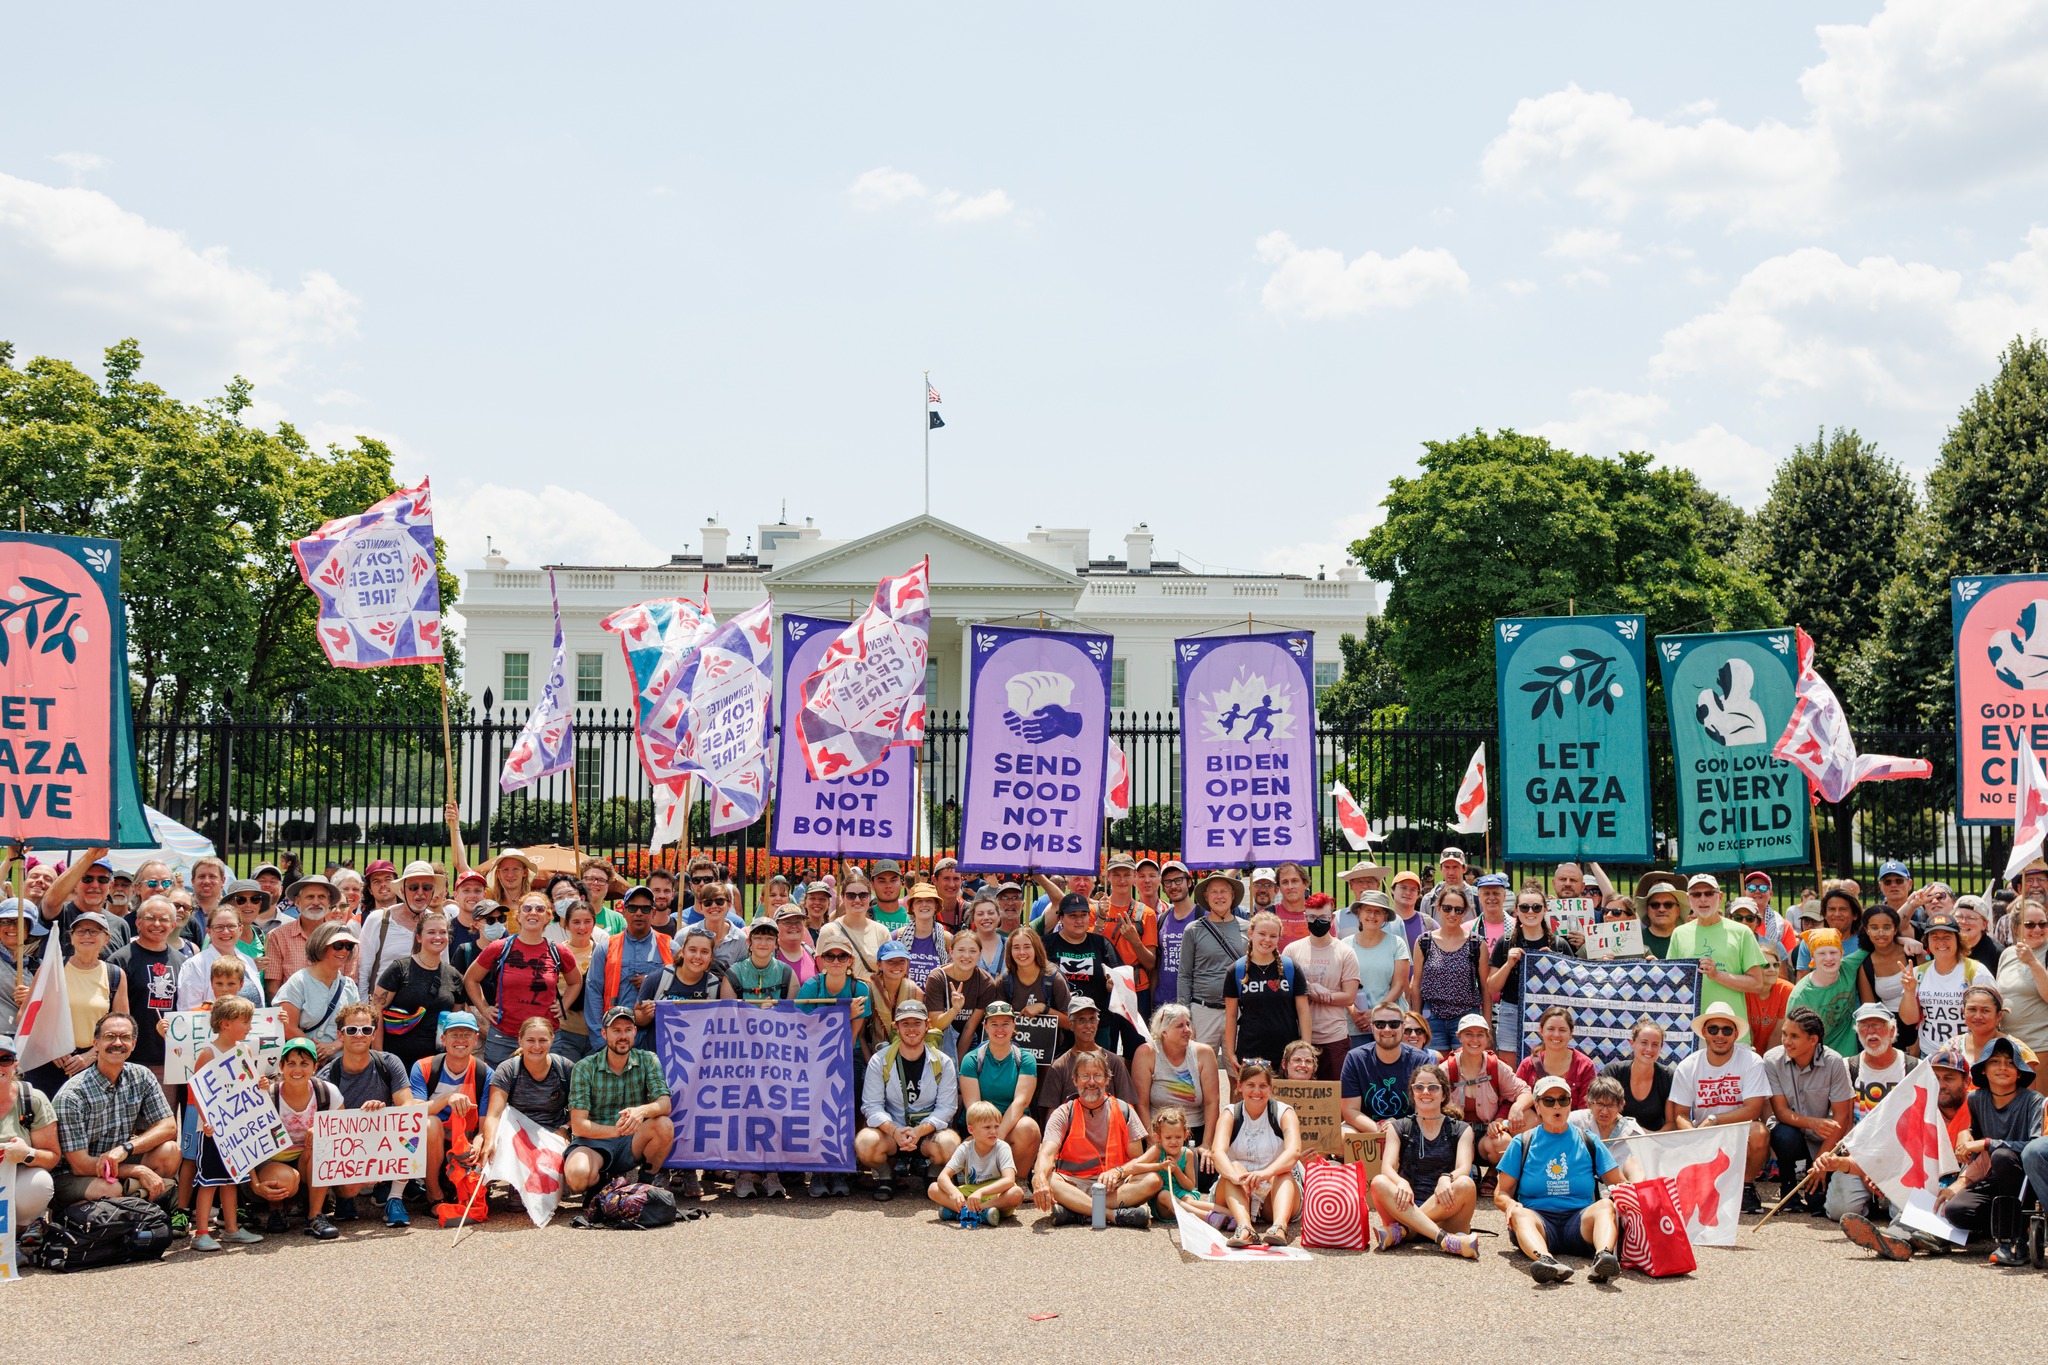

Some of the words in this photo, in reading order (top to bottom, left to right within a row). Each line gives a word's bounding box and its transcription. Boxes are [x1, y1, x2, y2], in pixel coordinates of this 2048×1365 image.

[1, 696, 56, 731] ET
[1980, 703, 2025, 719] GOD
[1981, 724, 2048, 751] EVE
[0, 738, 88, 775] AZA
[994, 752, 1082, 776] SEND
[1206, 753, 1289, 772] BIDEN
[1538, 742, 1600, 769] LET
[1695, 758, 1729, 774] GOD
[805, 768, 890, 787] OD
[1205, 776, 1290, 797] OPEN
[1697, 773, 1789, 803] EVERY
[0, 783, 72, 819] IVE
[993, 780, 1081, 802] FOOD
[1525, 776, 1626, 805] GAZA
[1980, 792, 2003, 804] NO
[815, 792, 878, 812] NOT
[1206, 801, 1292, 823] YOUR
[793, 816, 893, 838] BOMBS
[1003, 807, 1068, 827] NOT
[1537, 811, 1616, 838] LIVE
[1698, 803, 1792, 836] CHILD
[981, 831, 1083, 854] BOMBS
[1207, 826, 1292, 847] EYES
[1697, 841, 1715, 852] NO
[1718, 834, 1792, 851] EXCEPTIONS
[1886, 861, 1897, 870] KC
[1056, 951, 1097, 960] LIBERATE
[908, 967, 930, 975] CEAS
[908, 973, 927, 981] FIR
[1919, 998, 1954, 1006] RISTIANS
[703, 1018, 740, 1036] ALL
[746, 1018, 808, 1041] GOD'S
[1014, 1015, 1058, 1029] CISCANS
[1015, 1032, 1031, 1042] OR
[702, 1041, 809, 1063] CHILDREN
[194, 1054, 236, 1108] LET
[699, 1065, 756, 1080] MARCH
[760, 1066, 792, 1081] FOR
[797, 1069, 809, 1083] A
[1272, 1086, 1333, 1099] CHRISTIANS
[1700, 1080, 1739, 1091] PEACE
[696, 1085, 810, 1111] CEASE
[1703, 1095, 1737, 1105] TEAM
[318, 1112, 423, 1138] MENNONITES
[1299, 1115, 1334, 1126] SEFIRE
[219, 1109, 277, 1159] CHILDREN
[693, 1115, 810, 1153] FIRE
[1301, 1131, 1319, 1141] OW
[333, 1137, 367, 1158] FOR
[377, 1136, 392, 1152] A
[318, 1158, 410, 1181] CEASEFIRE
